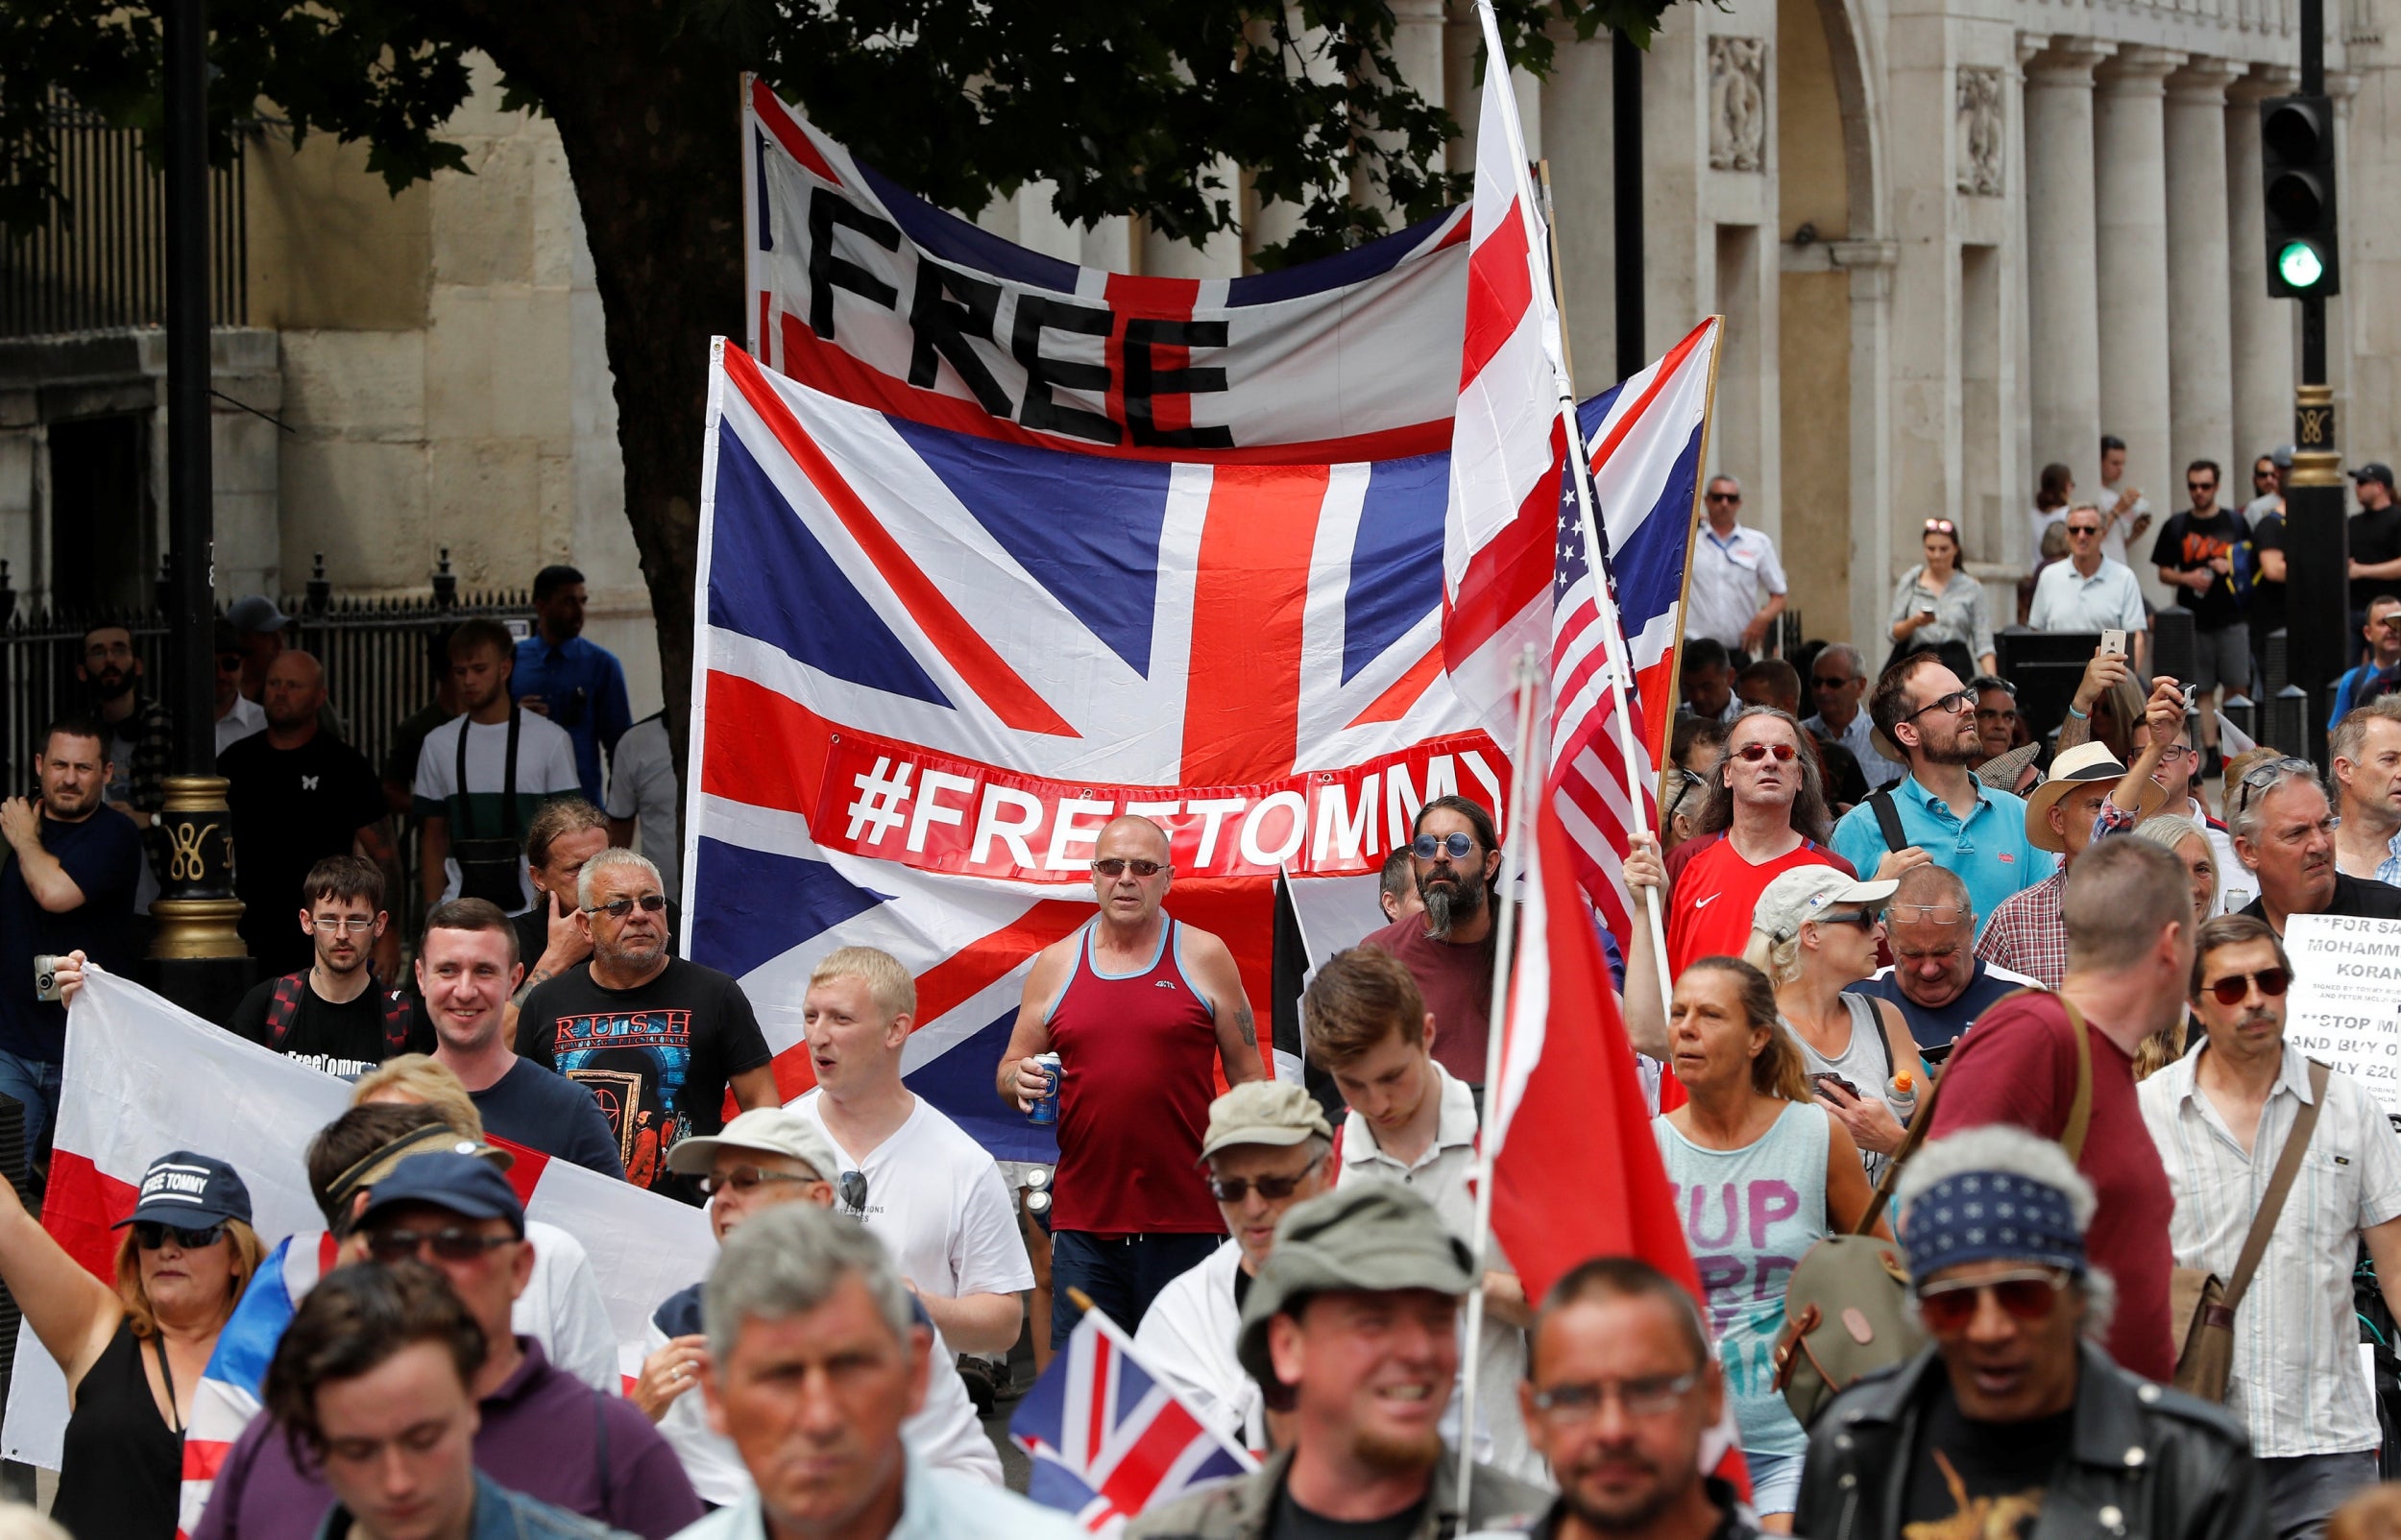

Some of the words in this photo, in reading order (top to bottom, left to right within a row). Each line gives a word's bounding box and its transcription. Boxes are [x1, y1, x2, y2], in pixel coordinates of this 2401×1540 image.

[809, 186, 1236, 448] FREE
[556, 1013, 691, 1041] RUSH
[554, 1038, 608, 1051] MOVING
[618, 1036, 690, 1046] PICTURES
[2292, 1035, 2332, 1050] AND
[2338, 1039, 2378, 1053] BUY
[279, 1050, 377, 1076] FreeTomm
[140, 1172, 167, 1196] FREE
[166, 1172, 207, 1194] TOMMY
[1670, 1179, 1800, 1250] UP
